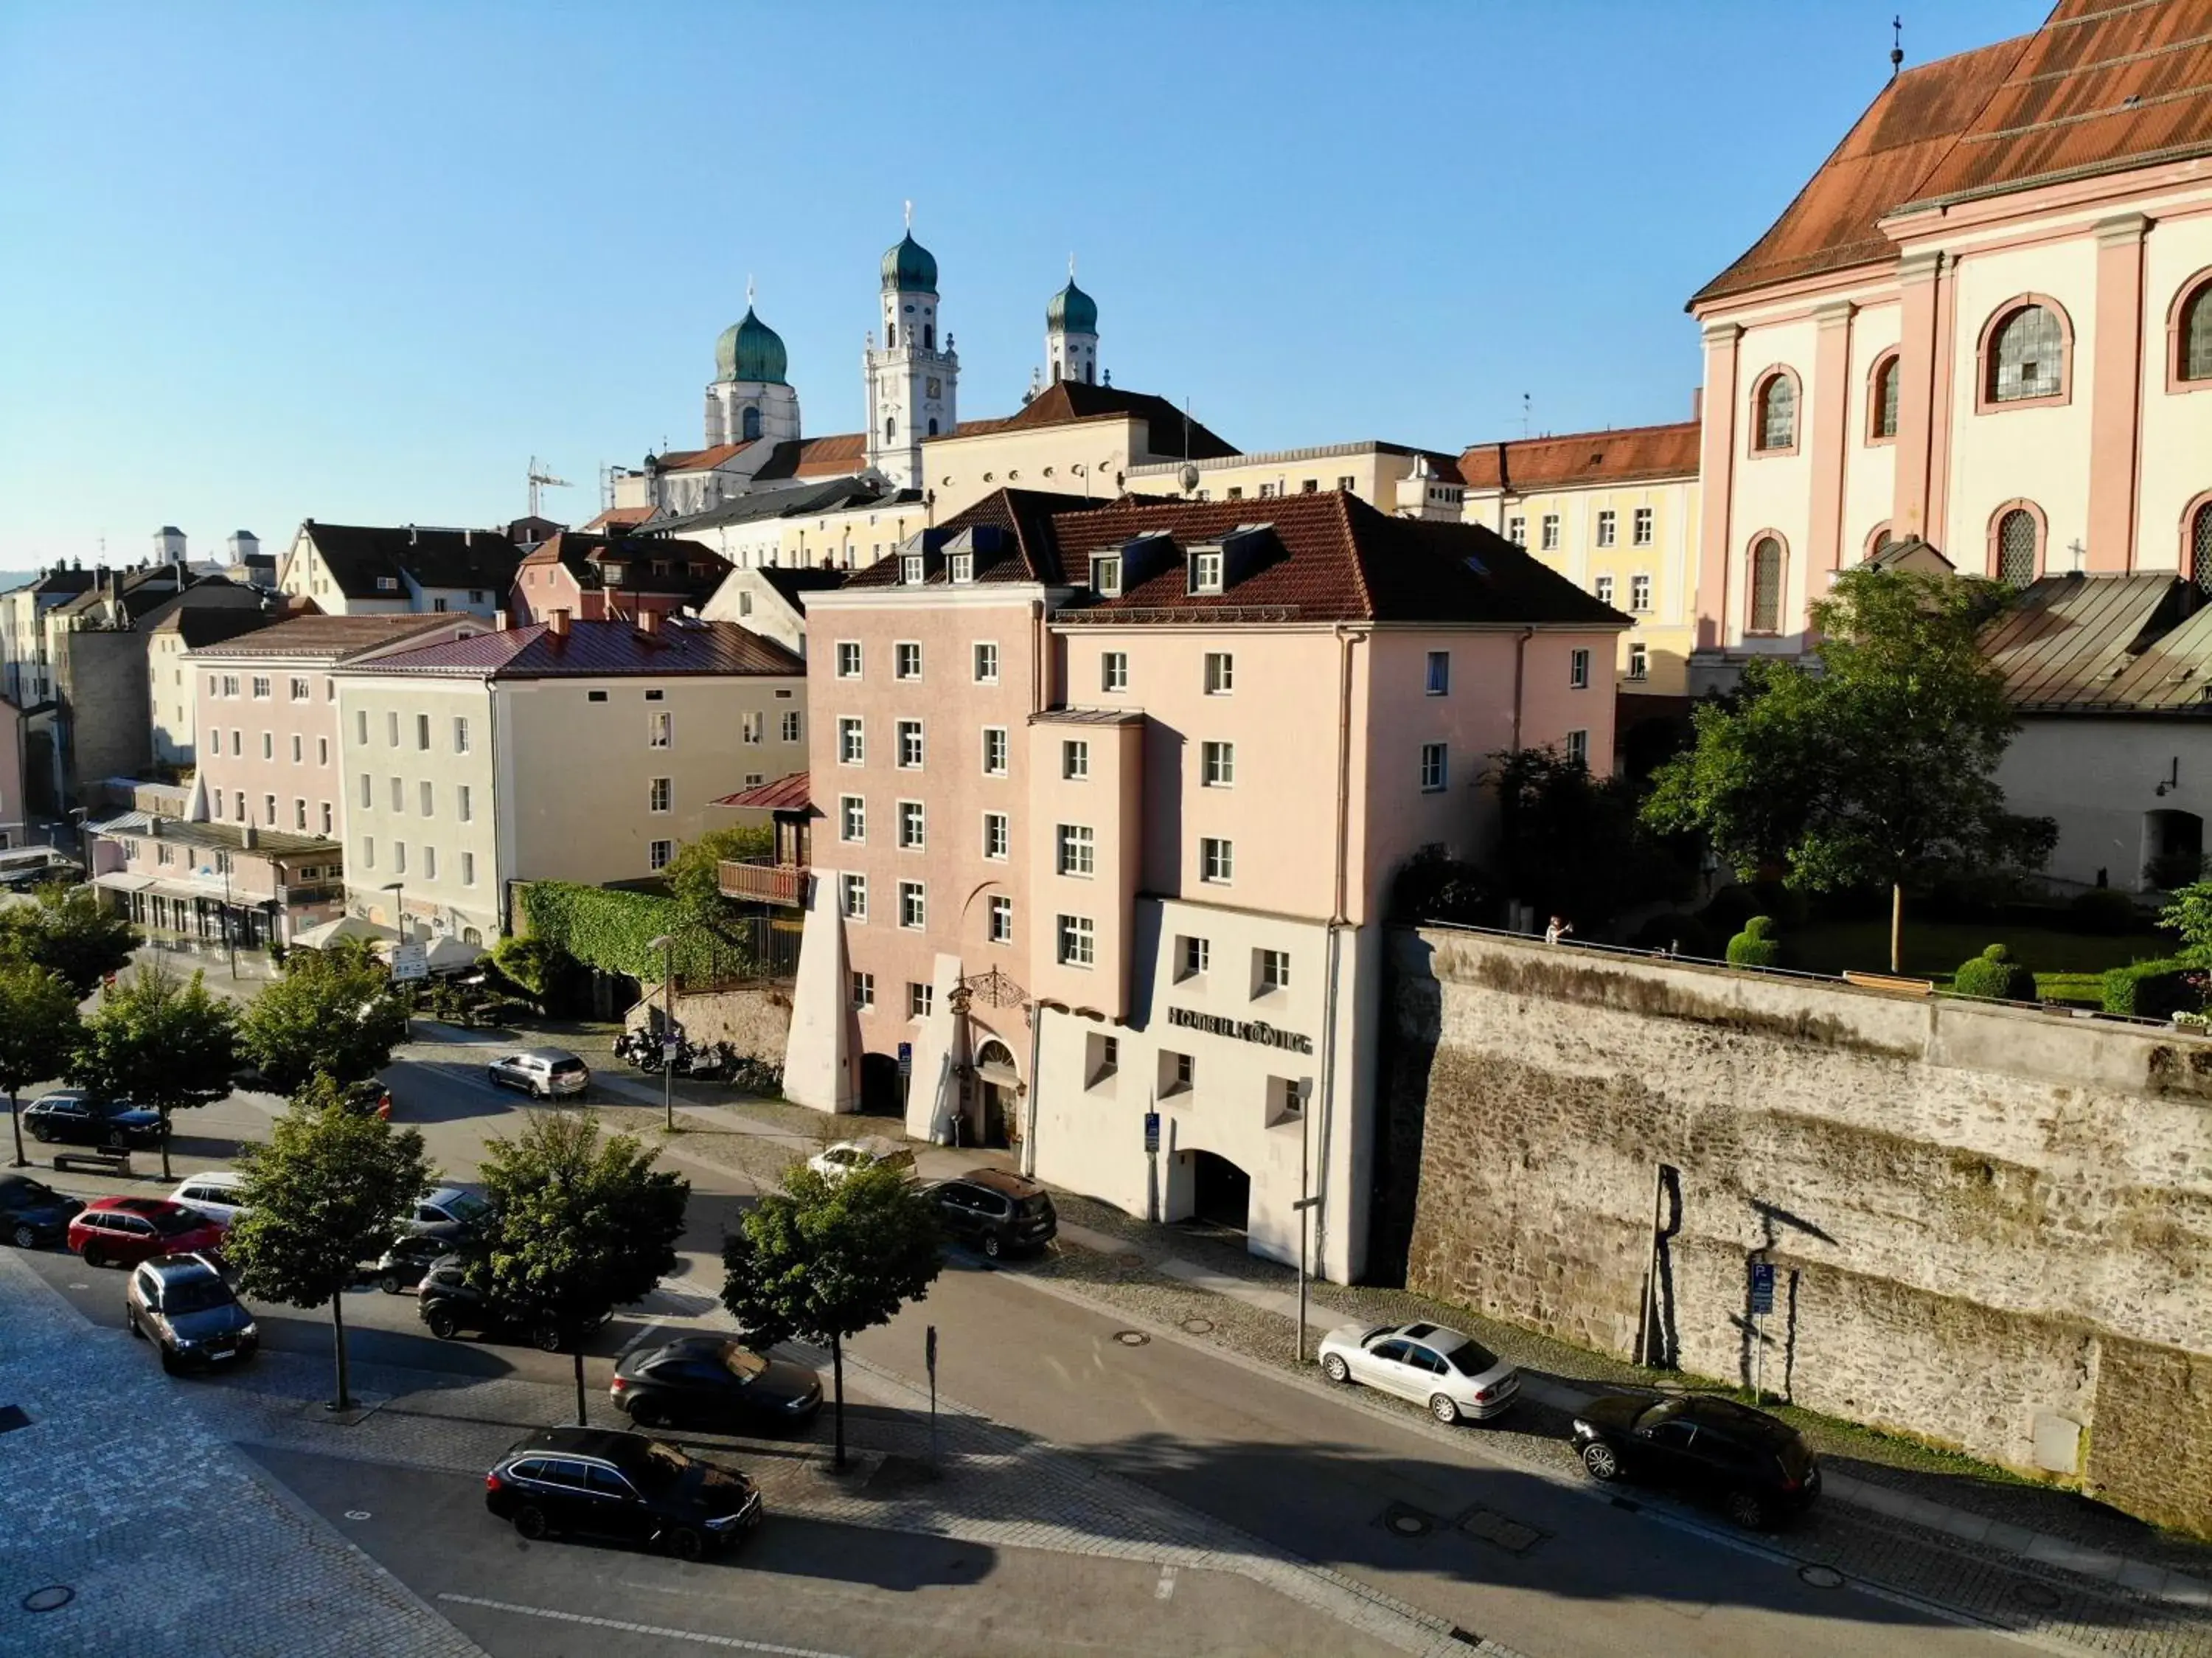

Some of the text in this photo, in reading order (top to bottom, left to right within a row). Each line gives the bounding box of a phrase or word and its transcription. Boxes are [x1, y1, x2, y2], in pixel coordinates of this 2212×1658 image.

[1167, 1005, 1312, 1055] HOTEL KÖNIG
[1756, 1265, 1766, 1277] P
